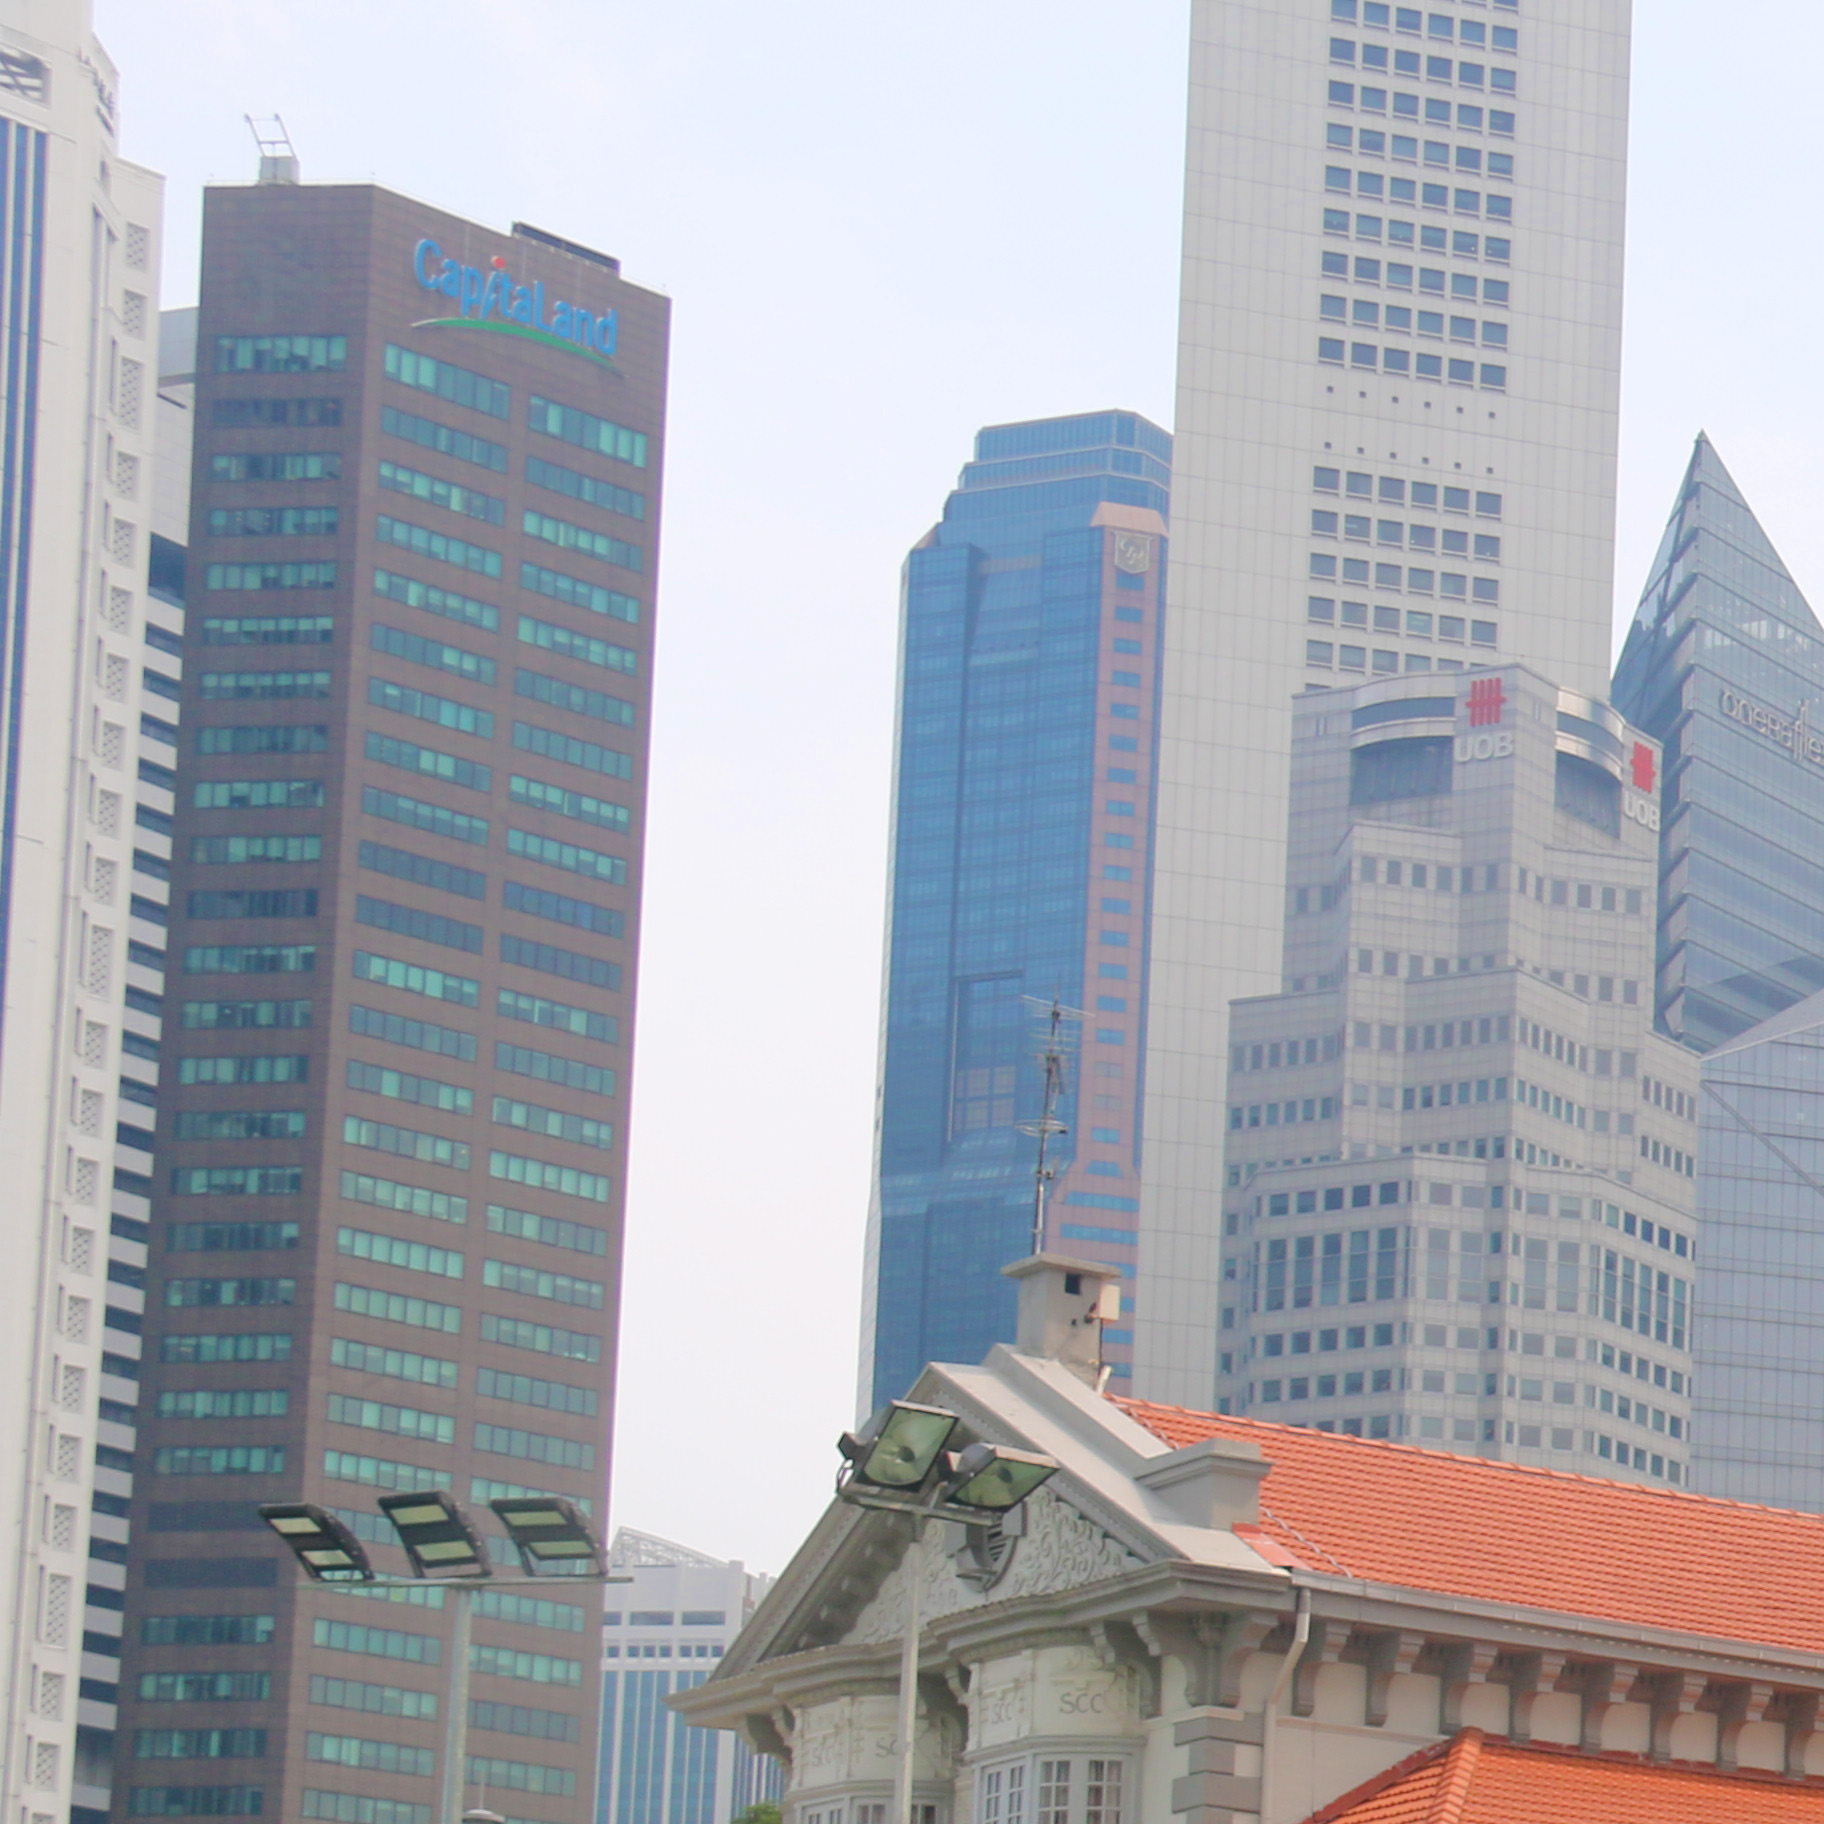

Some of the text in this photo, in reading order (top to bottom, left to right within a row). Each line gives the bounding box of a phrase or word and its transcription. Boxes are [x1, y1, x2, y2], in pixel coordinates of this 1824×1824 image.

[414, 239, 618, 355] CapitaLand
[1454, 732, 1514, 763] UOB
[1623, 790, 1661, 832] UOB
[1059, 1693, 1102, 1714] SCC
